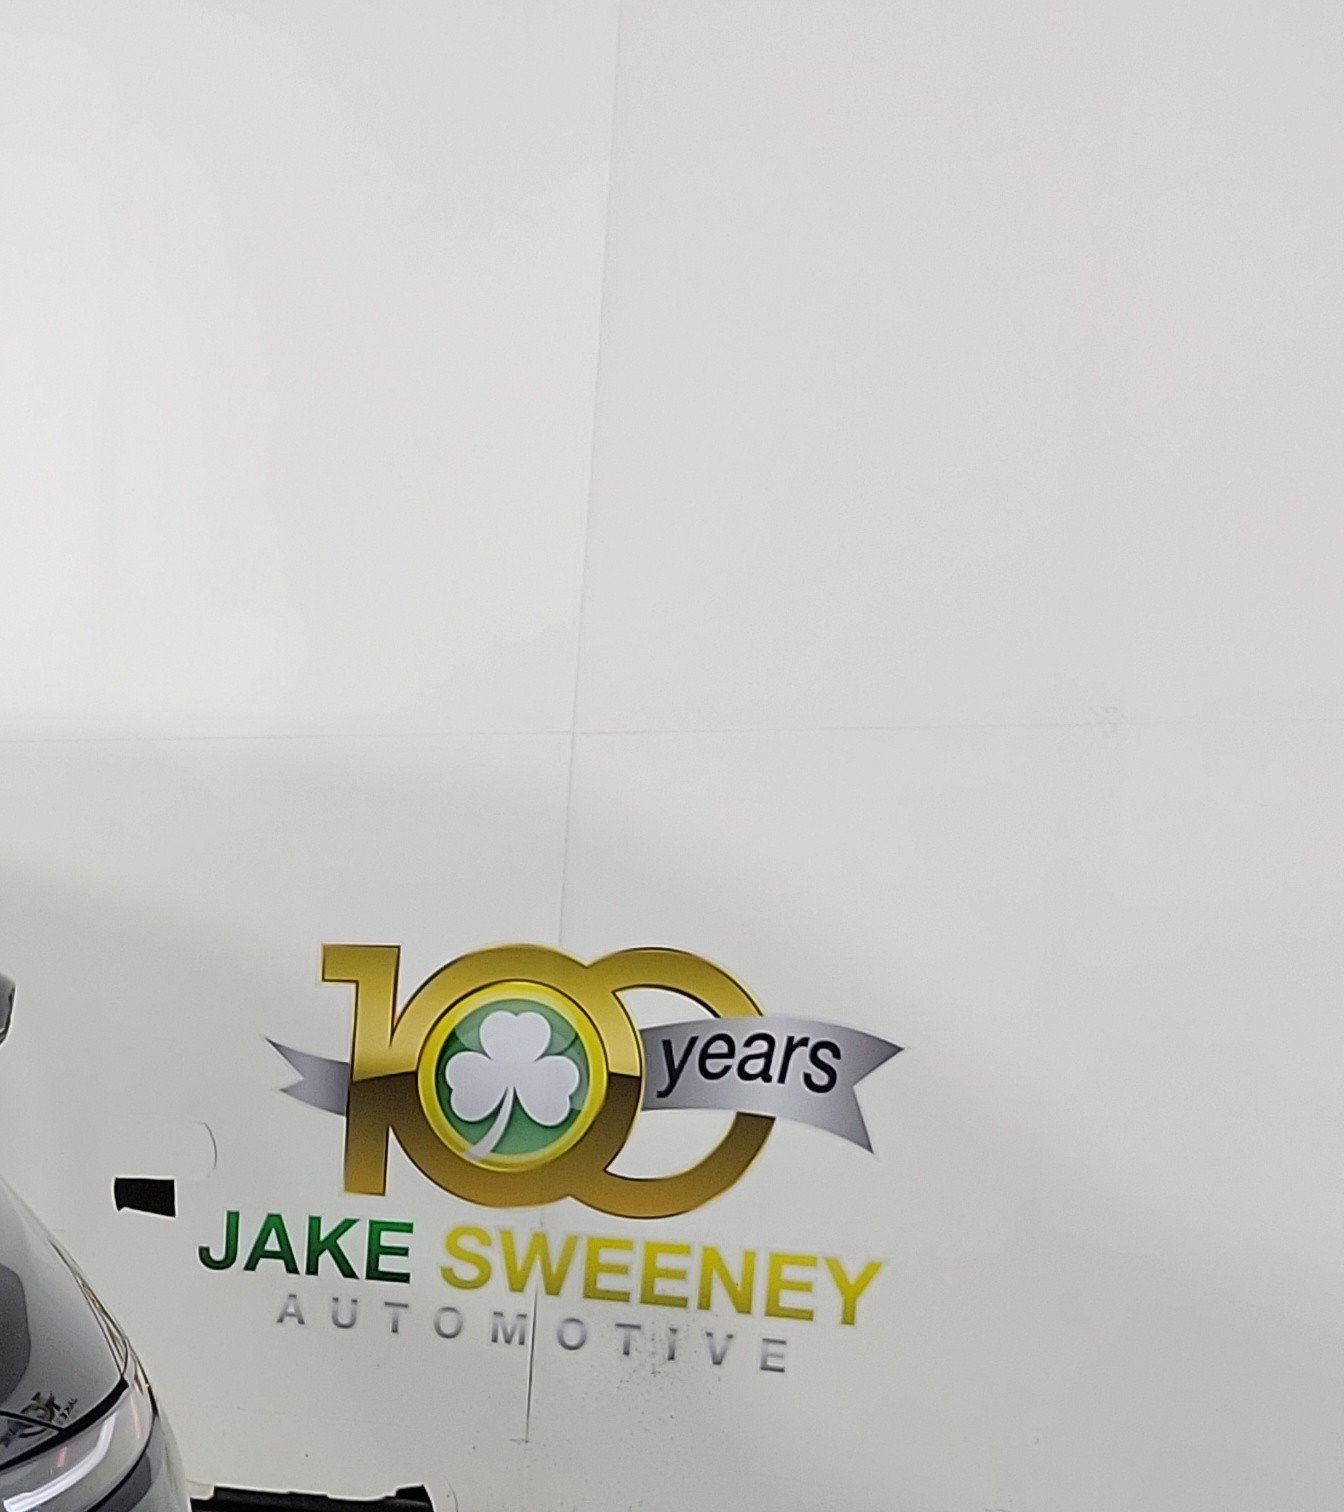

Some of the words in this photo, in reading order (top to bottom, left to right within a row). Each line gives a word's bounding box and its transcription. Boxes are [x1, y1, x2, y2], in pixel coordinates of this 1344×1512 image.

[321, 943, 776, 1218] 100
[656, 1031, 842, 1098] years
[198, 1210, 413, 1284] JAKE
[439, 1226, 883, 1326] SWEENEY
[276, 1294, 787, 1373] AUTOMOTIVE
